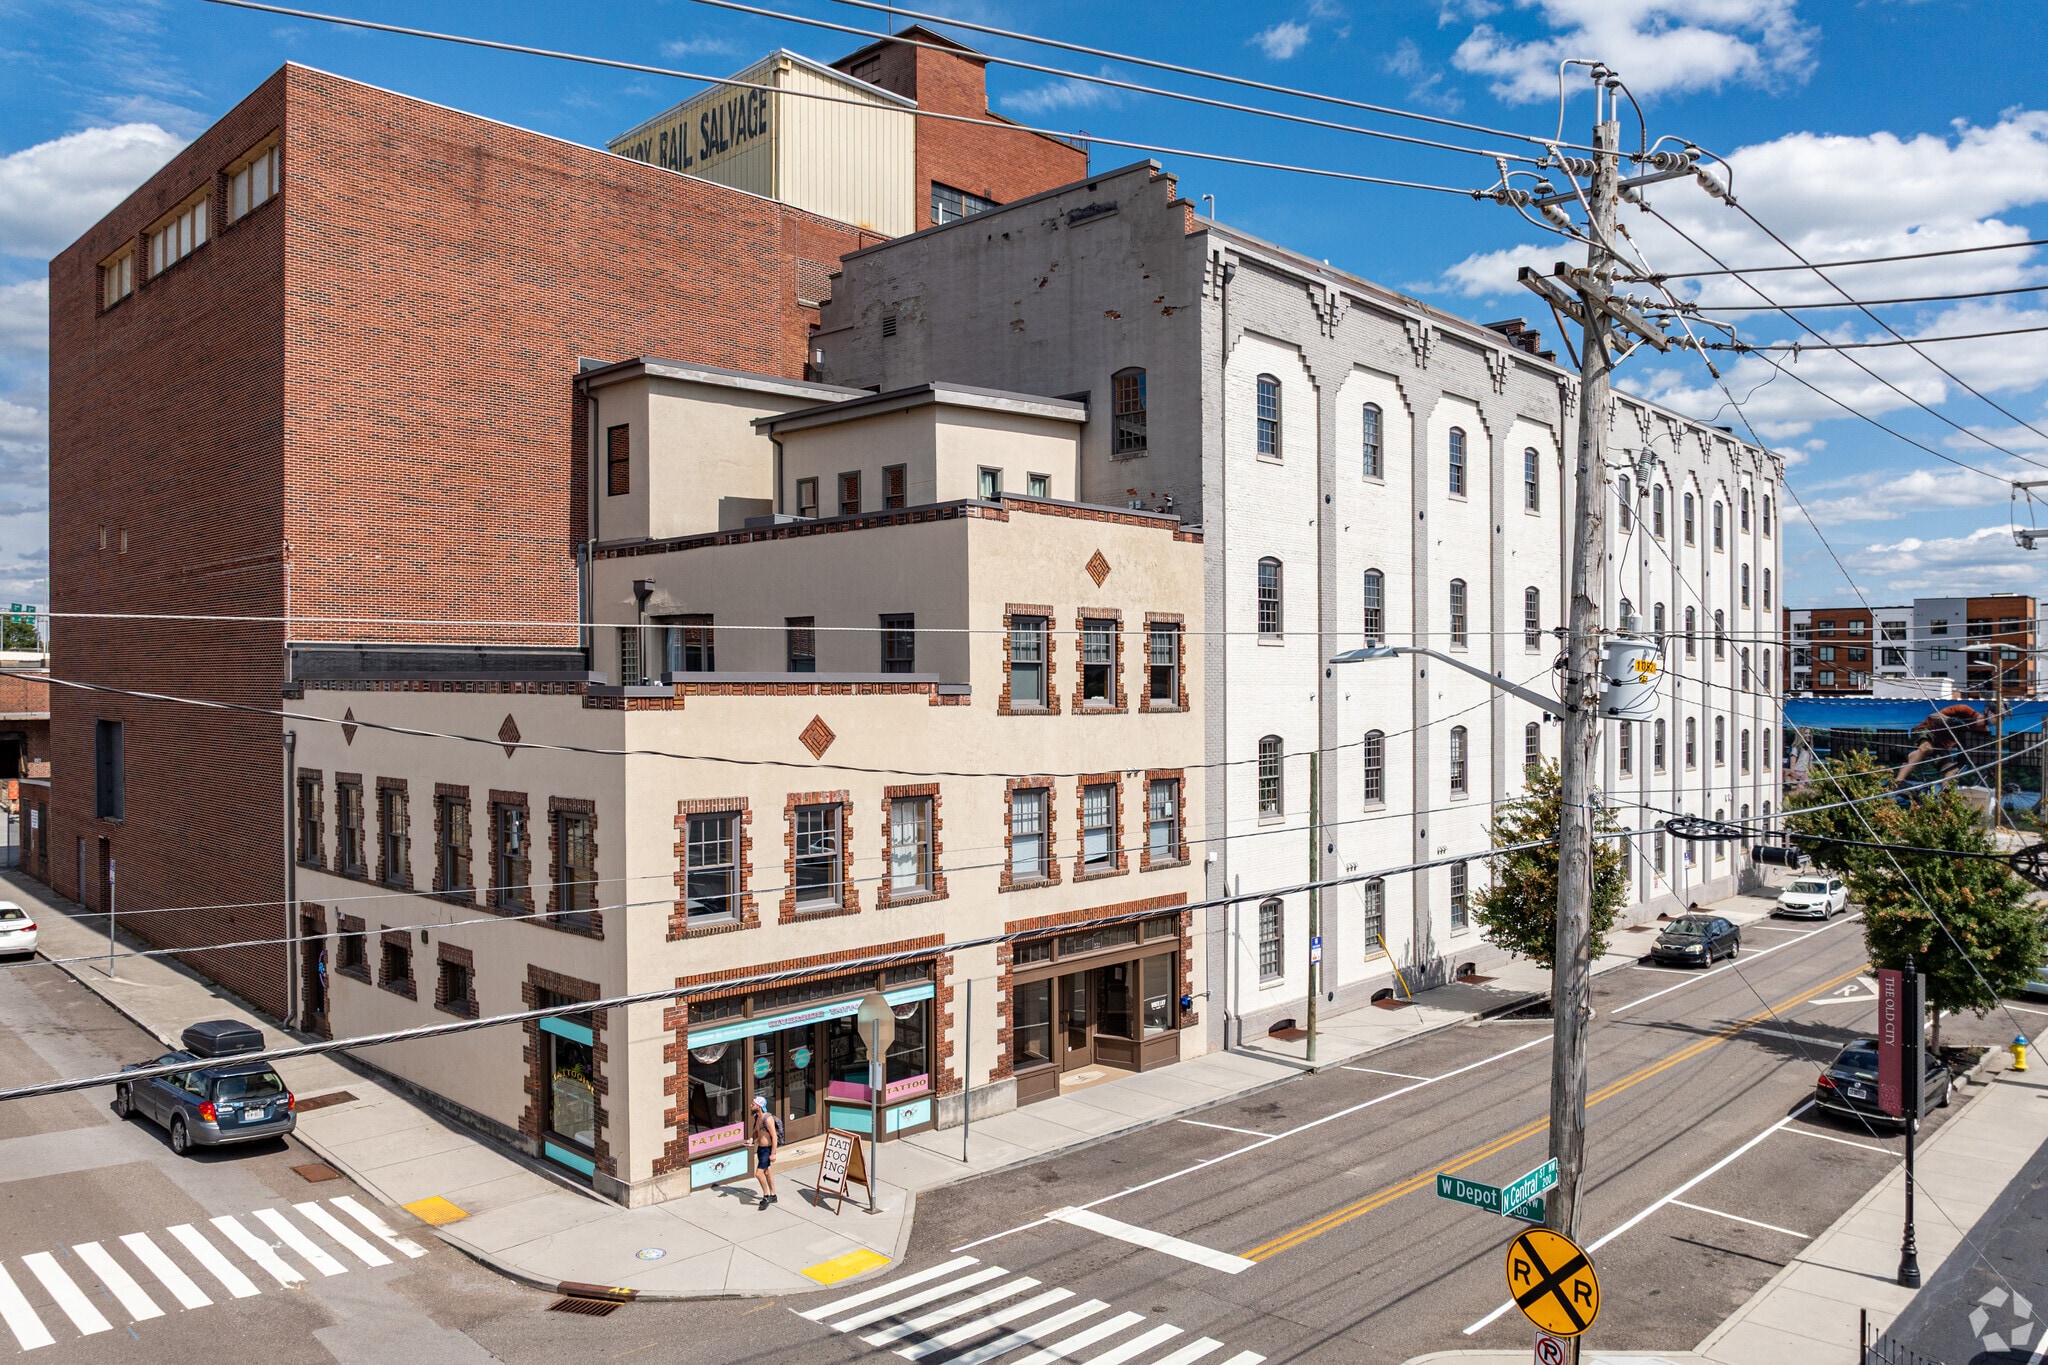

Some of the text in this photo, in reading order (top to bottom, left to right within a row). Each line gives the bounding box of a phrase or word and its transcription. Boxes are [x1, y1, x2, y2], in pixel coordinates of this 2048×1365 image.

[659, 121, 692, 171] RAIL
[701, 84, 766, 160] SALVAGE
[1885, 977, 1895, 1047] THE OLD CITY
[886, 1079, 926, 1094] TATTOO
[690, 1128, 741, 1147] TATTOO
[828, 1136, 850, 1151] TAT
[826, 1148, 847, 1163] TOO
[824, 1160, 845, 1175] ING
[1503, 1161, 1555, 1211] N Central ST NW
[1542, 1174, 1552, 1187] 200
[1441, 1178, 1452, 1195] W
[1456, 1181, 1497, 1206] Depot
[1514, 1258, 1592, 1308] R R
[1544, 1342, 1558, 1361] P
